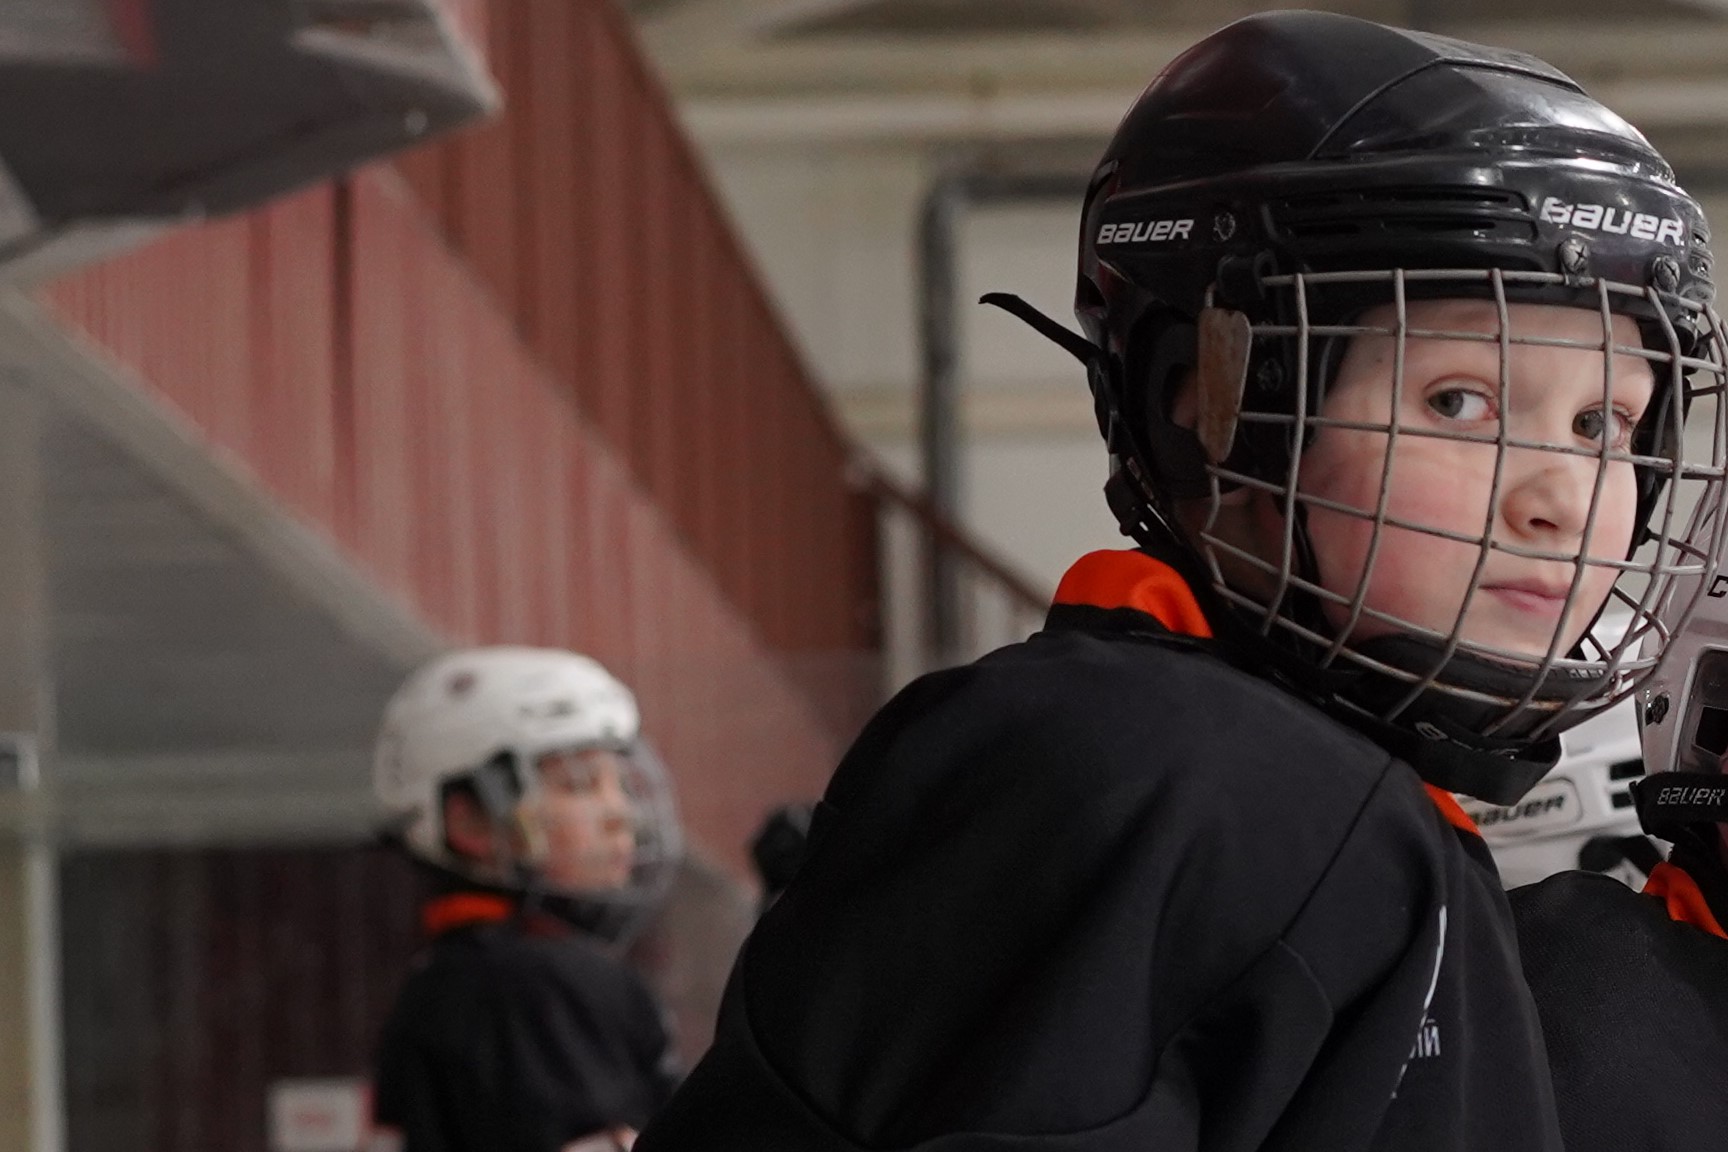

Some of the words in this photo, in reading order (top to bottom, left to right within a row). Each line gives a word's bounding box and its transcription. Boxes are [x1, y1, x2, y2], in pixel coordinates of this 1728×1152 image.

[1096, 219, 1195, 244] BAUER
[1540, 196, 1684, 246] BAUER
[1657, 787, 1726, 806] BAUER
